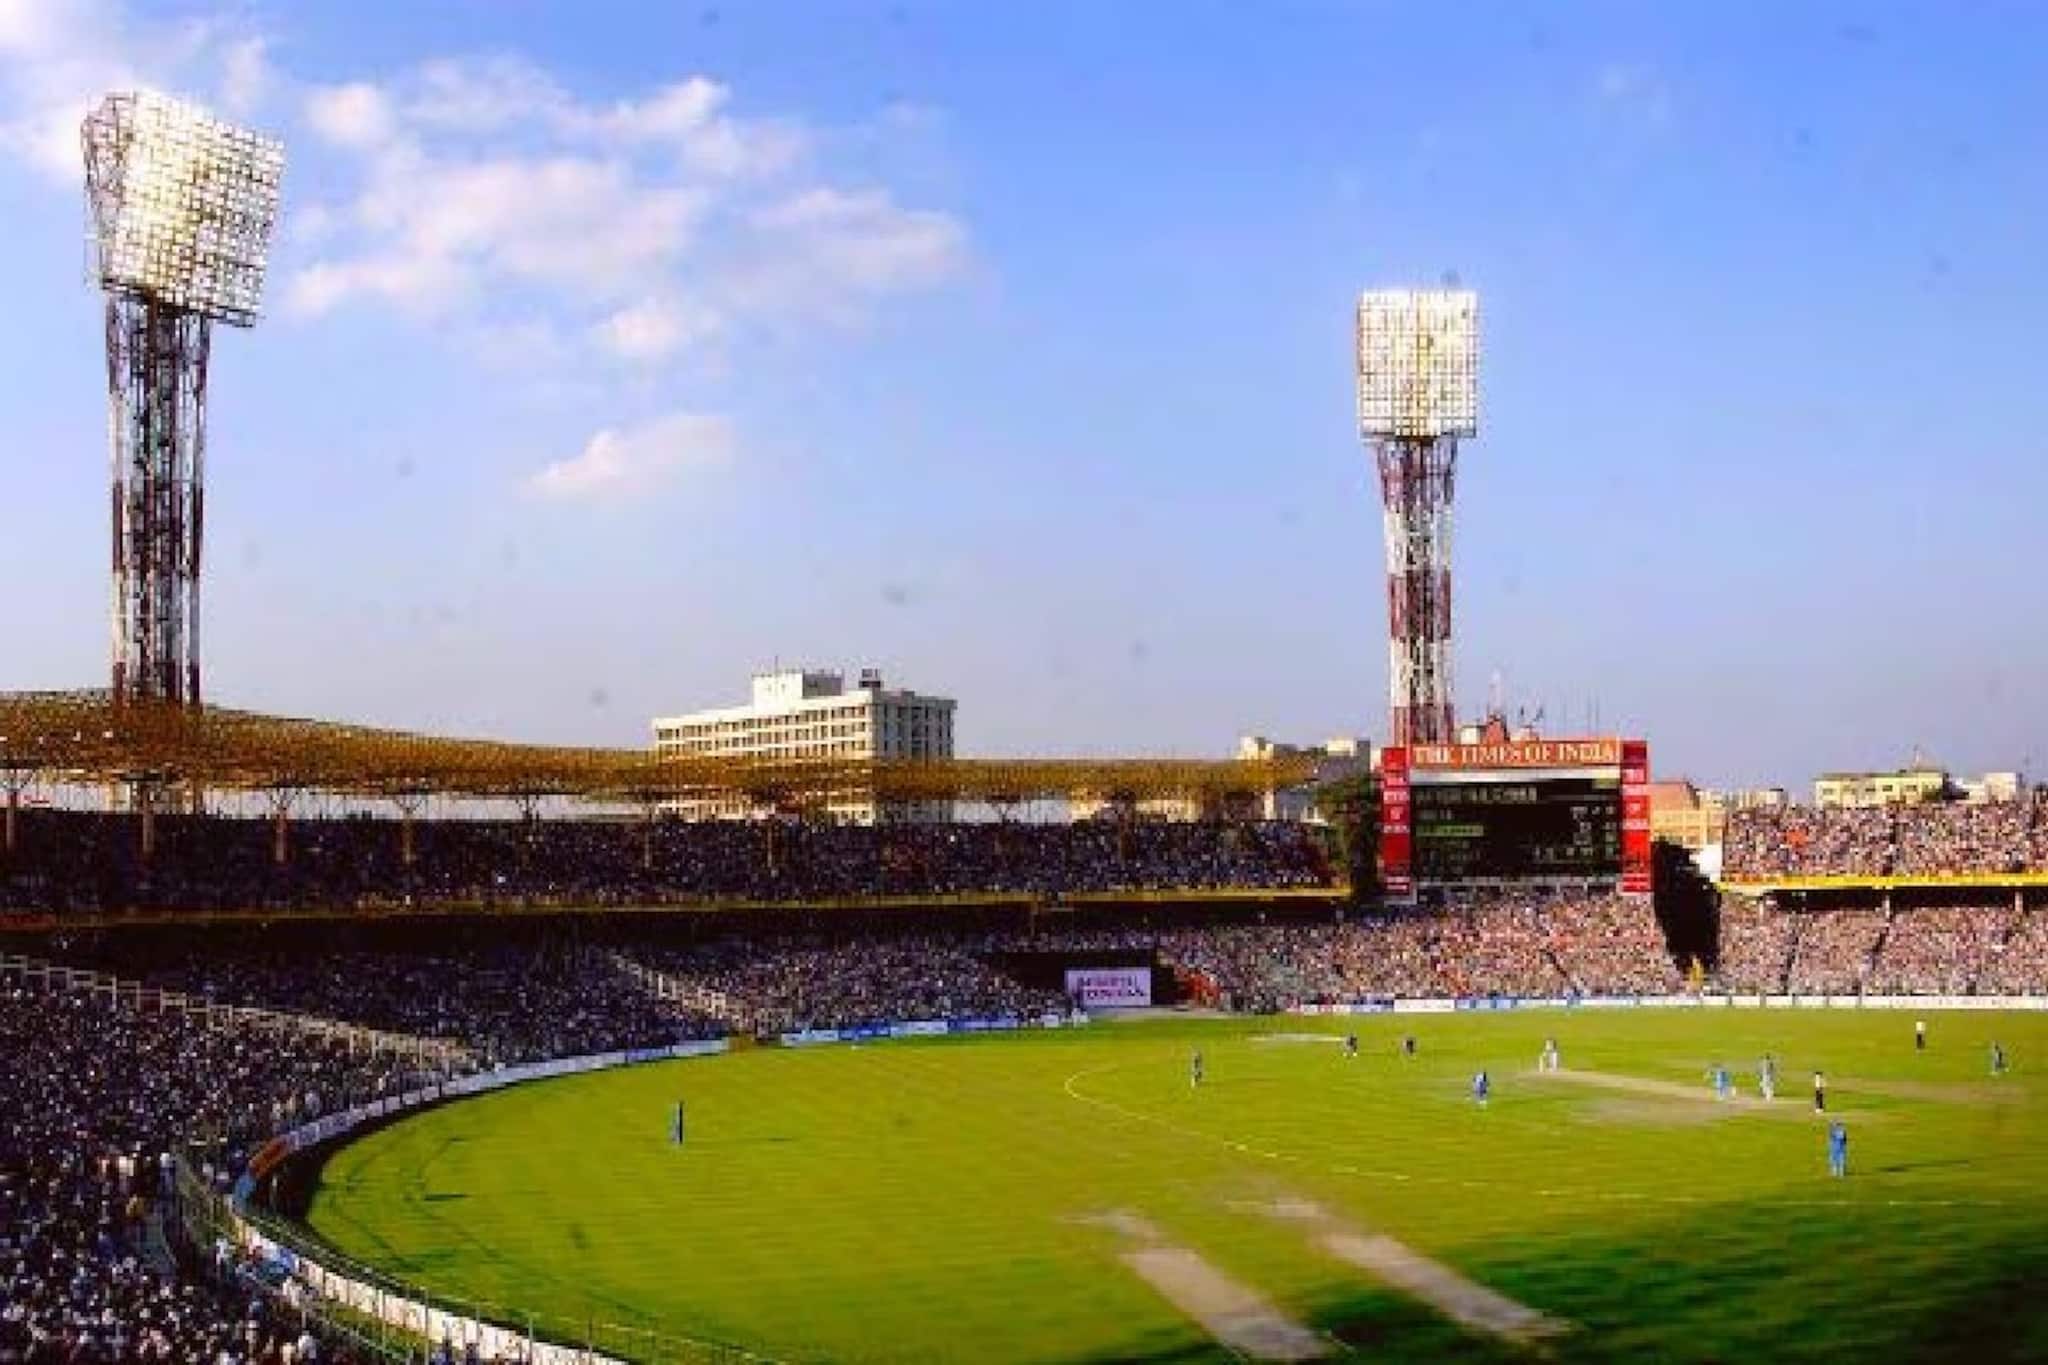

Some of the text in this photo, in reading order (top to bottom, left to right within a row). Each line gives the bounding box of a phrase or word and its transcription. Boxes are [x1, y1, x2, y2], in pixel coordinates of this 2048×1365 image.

[1414, 743, 1615, 763] THE TIMES OF INDIA
